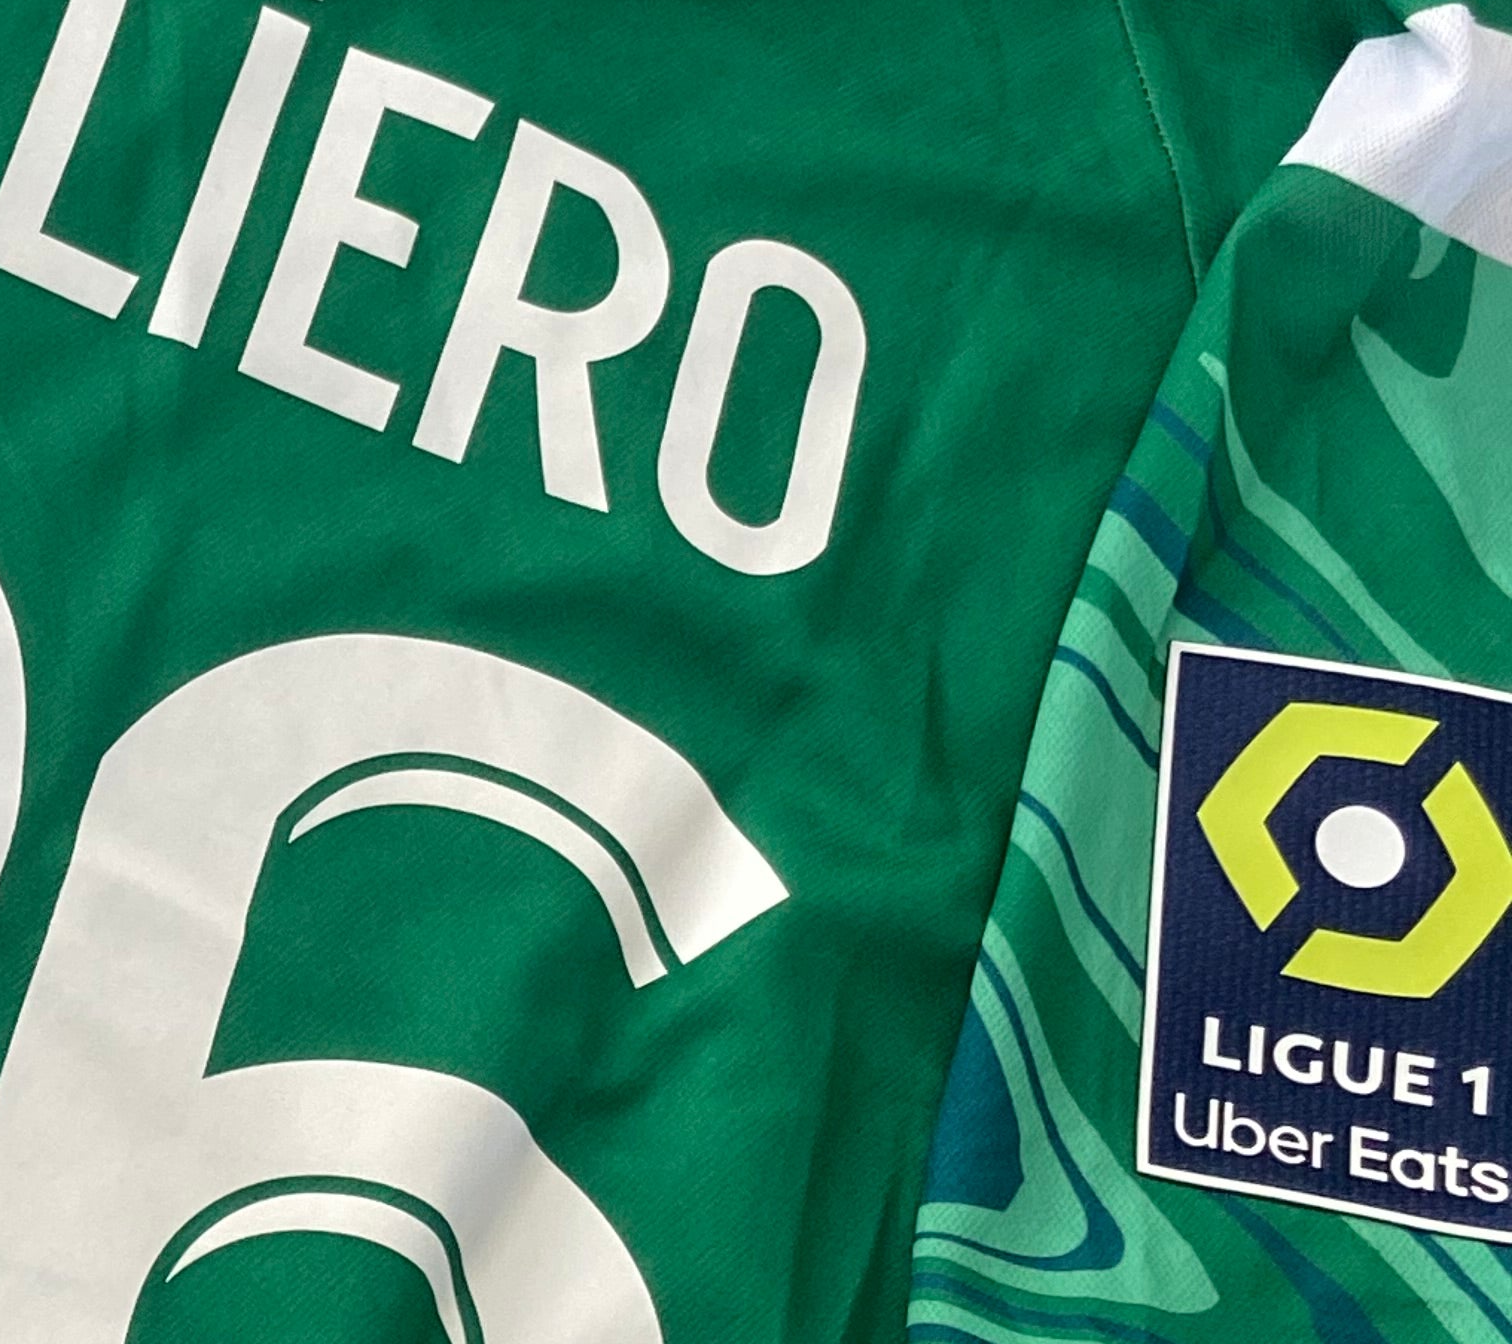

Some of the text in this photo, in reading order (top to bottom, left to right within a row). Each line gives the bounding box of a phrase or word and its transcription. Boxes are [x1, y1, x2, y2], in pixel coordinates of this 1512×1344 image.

[1201, 1016, 1492, 1117] LIGUE 1
[1173, 1091, 1511, 1205] Uber Eats
